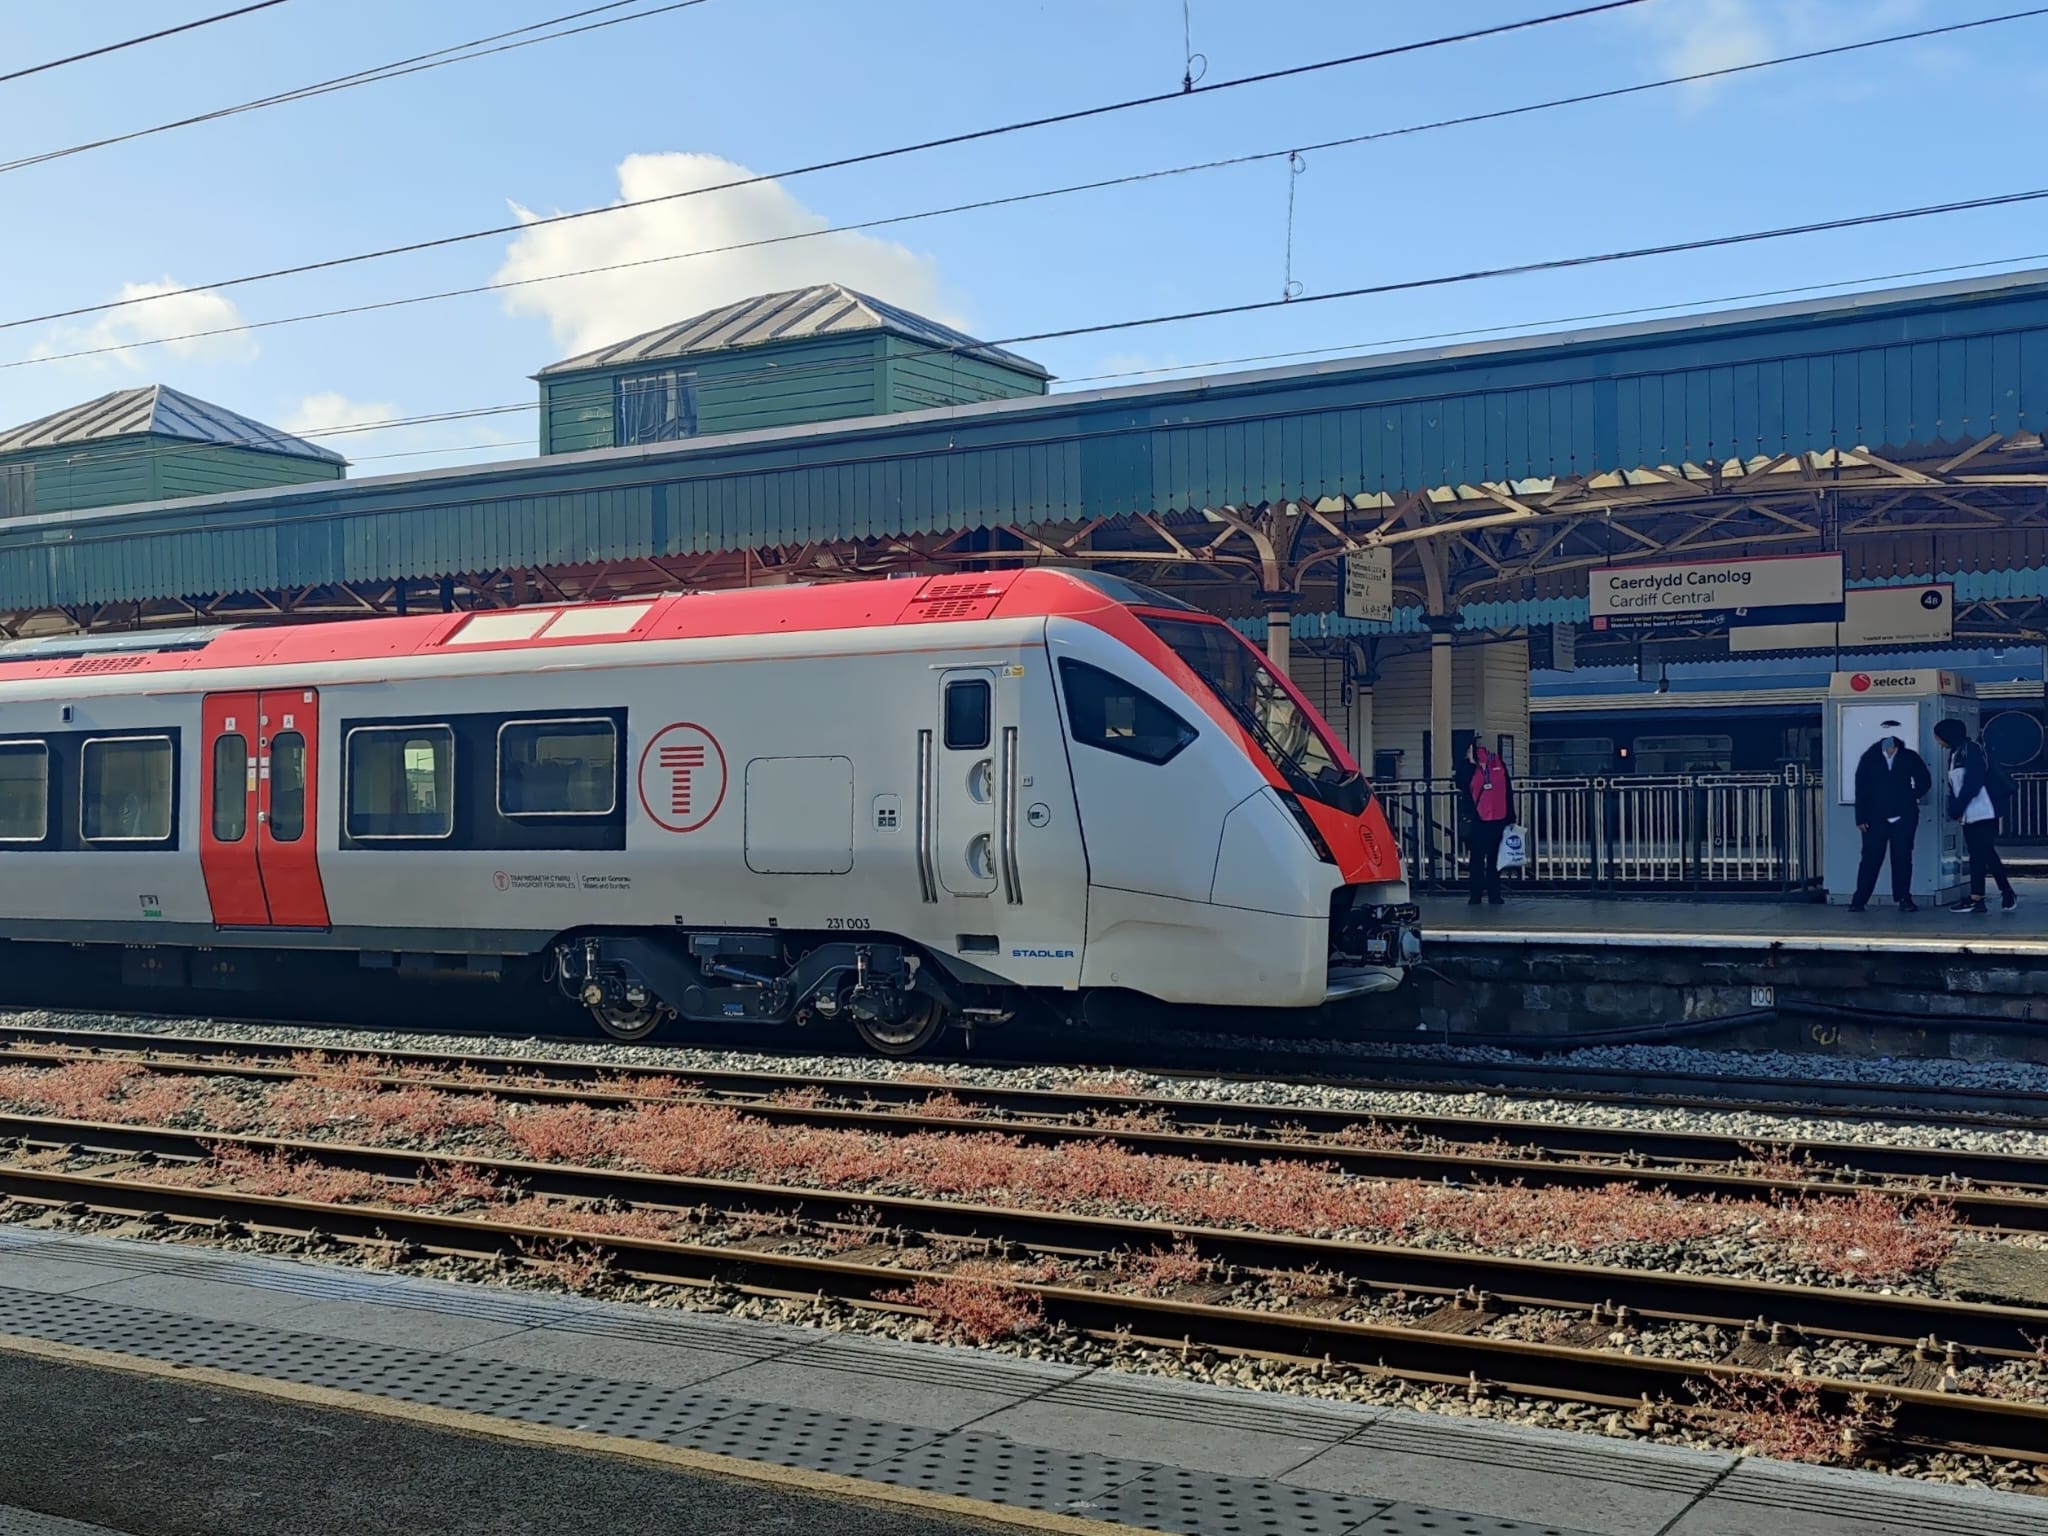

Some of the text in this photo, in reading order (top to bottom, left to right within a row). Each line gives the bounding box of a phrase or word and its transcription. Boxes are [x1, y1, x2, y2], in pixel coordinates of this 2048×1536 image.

[1610, 569, 1751, 590] Caerdydd Canolog
[1610, 589, 1714, 607] Cardiff Central
[1873, 676, 1916, 687] selecta
[660, 746, 704, 814] T
[827, 918, 870, 929] 231 003
